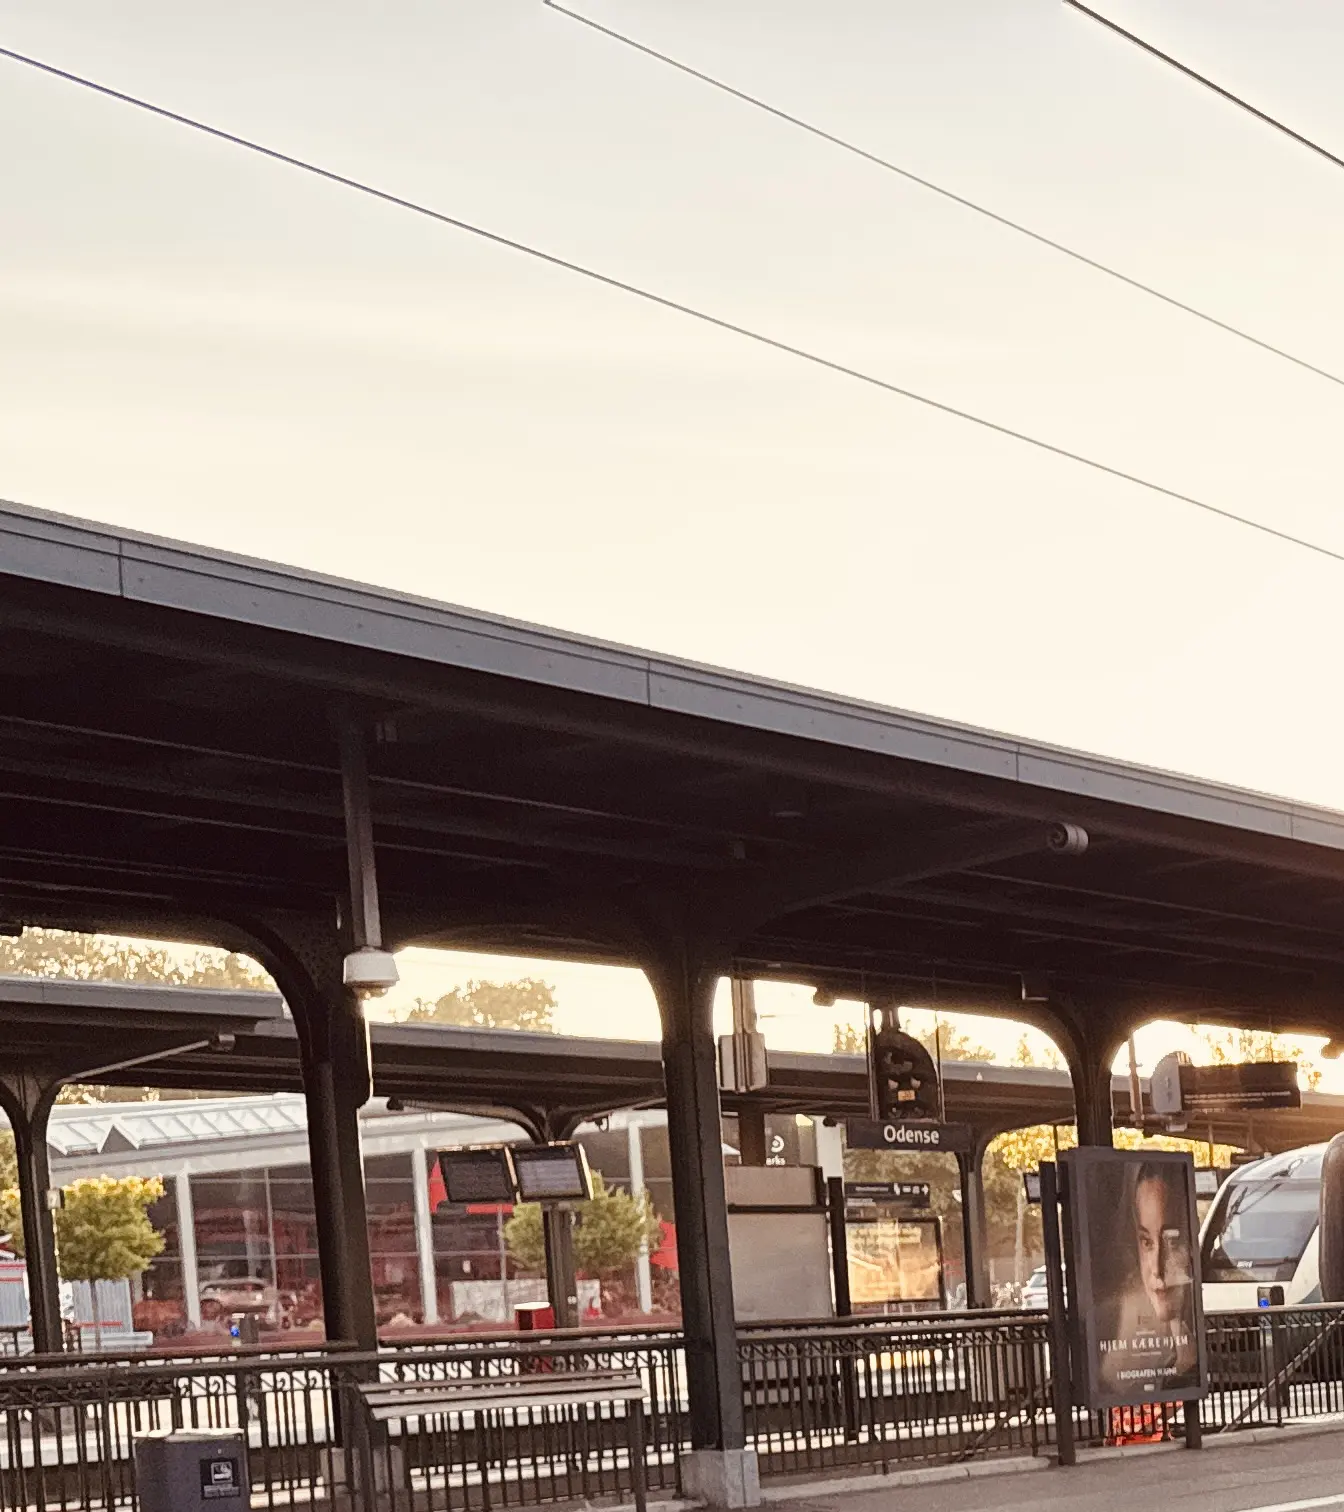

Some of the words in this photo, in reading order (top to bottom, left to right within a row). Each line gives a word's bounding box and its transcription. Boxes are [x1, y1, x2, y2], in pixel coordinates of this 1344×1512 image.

[883, 1124, 940, 1145] Odense
[1100, 1340, 1128, 1352] HJEM
[1132, 1337, 1161, 1349] KÆRE
[1163, 1335, 1188, 1349] HJEM
